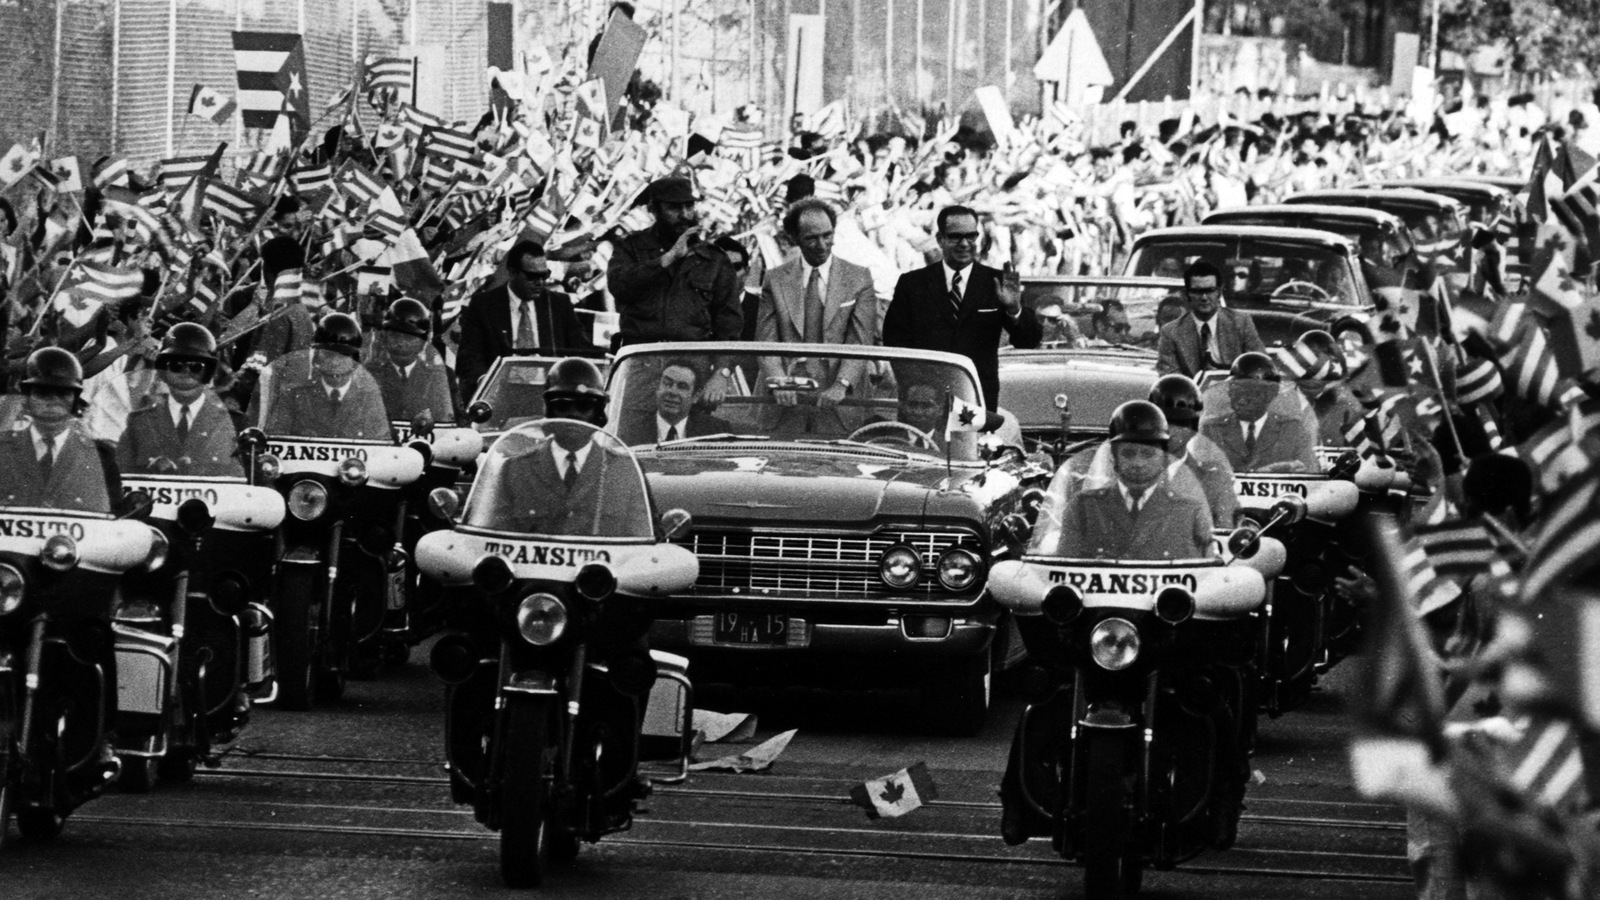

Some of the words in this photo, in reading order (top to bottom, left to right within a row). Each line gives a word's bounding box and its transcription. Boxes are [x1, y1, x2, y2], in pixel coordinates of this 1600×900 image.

[720, 612, 738, 633] 19
[767, 613, 785, 635] 15
[740, 626, 759, 643] HA
